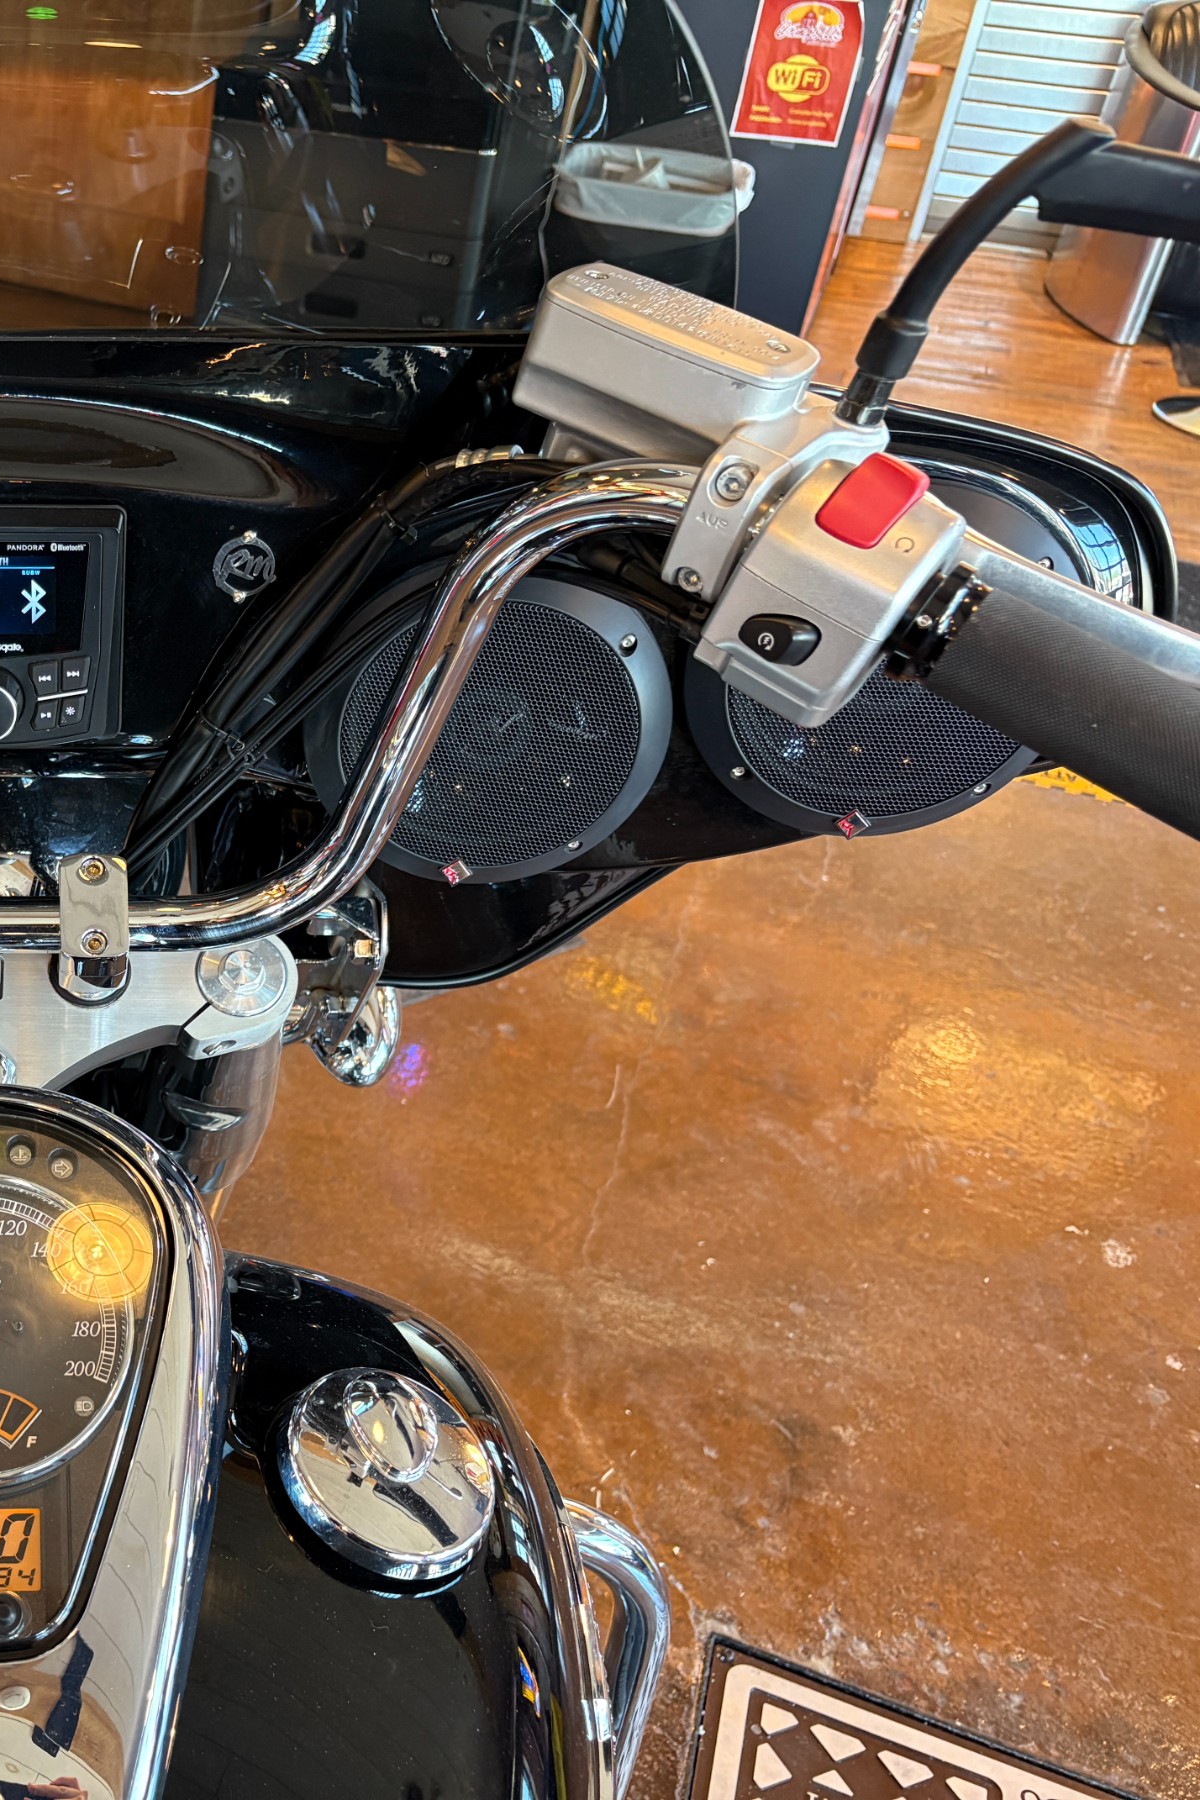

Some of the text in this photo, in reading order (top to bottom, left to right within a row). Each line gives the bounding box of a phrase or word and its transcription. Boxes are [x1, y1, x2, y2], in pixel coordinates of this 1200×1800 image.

[57, 544, 84, 552] Bluetooth
[30, 1242, 62, 1258] 140
[71, 1321, 101, 1338] 180
[64, 1360, 96, 1377] 200
[26, 1436, 37, 1448] F
